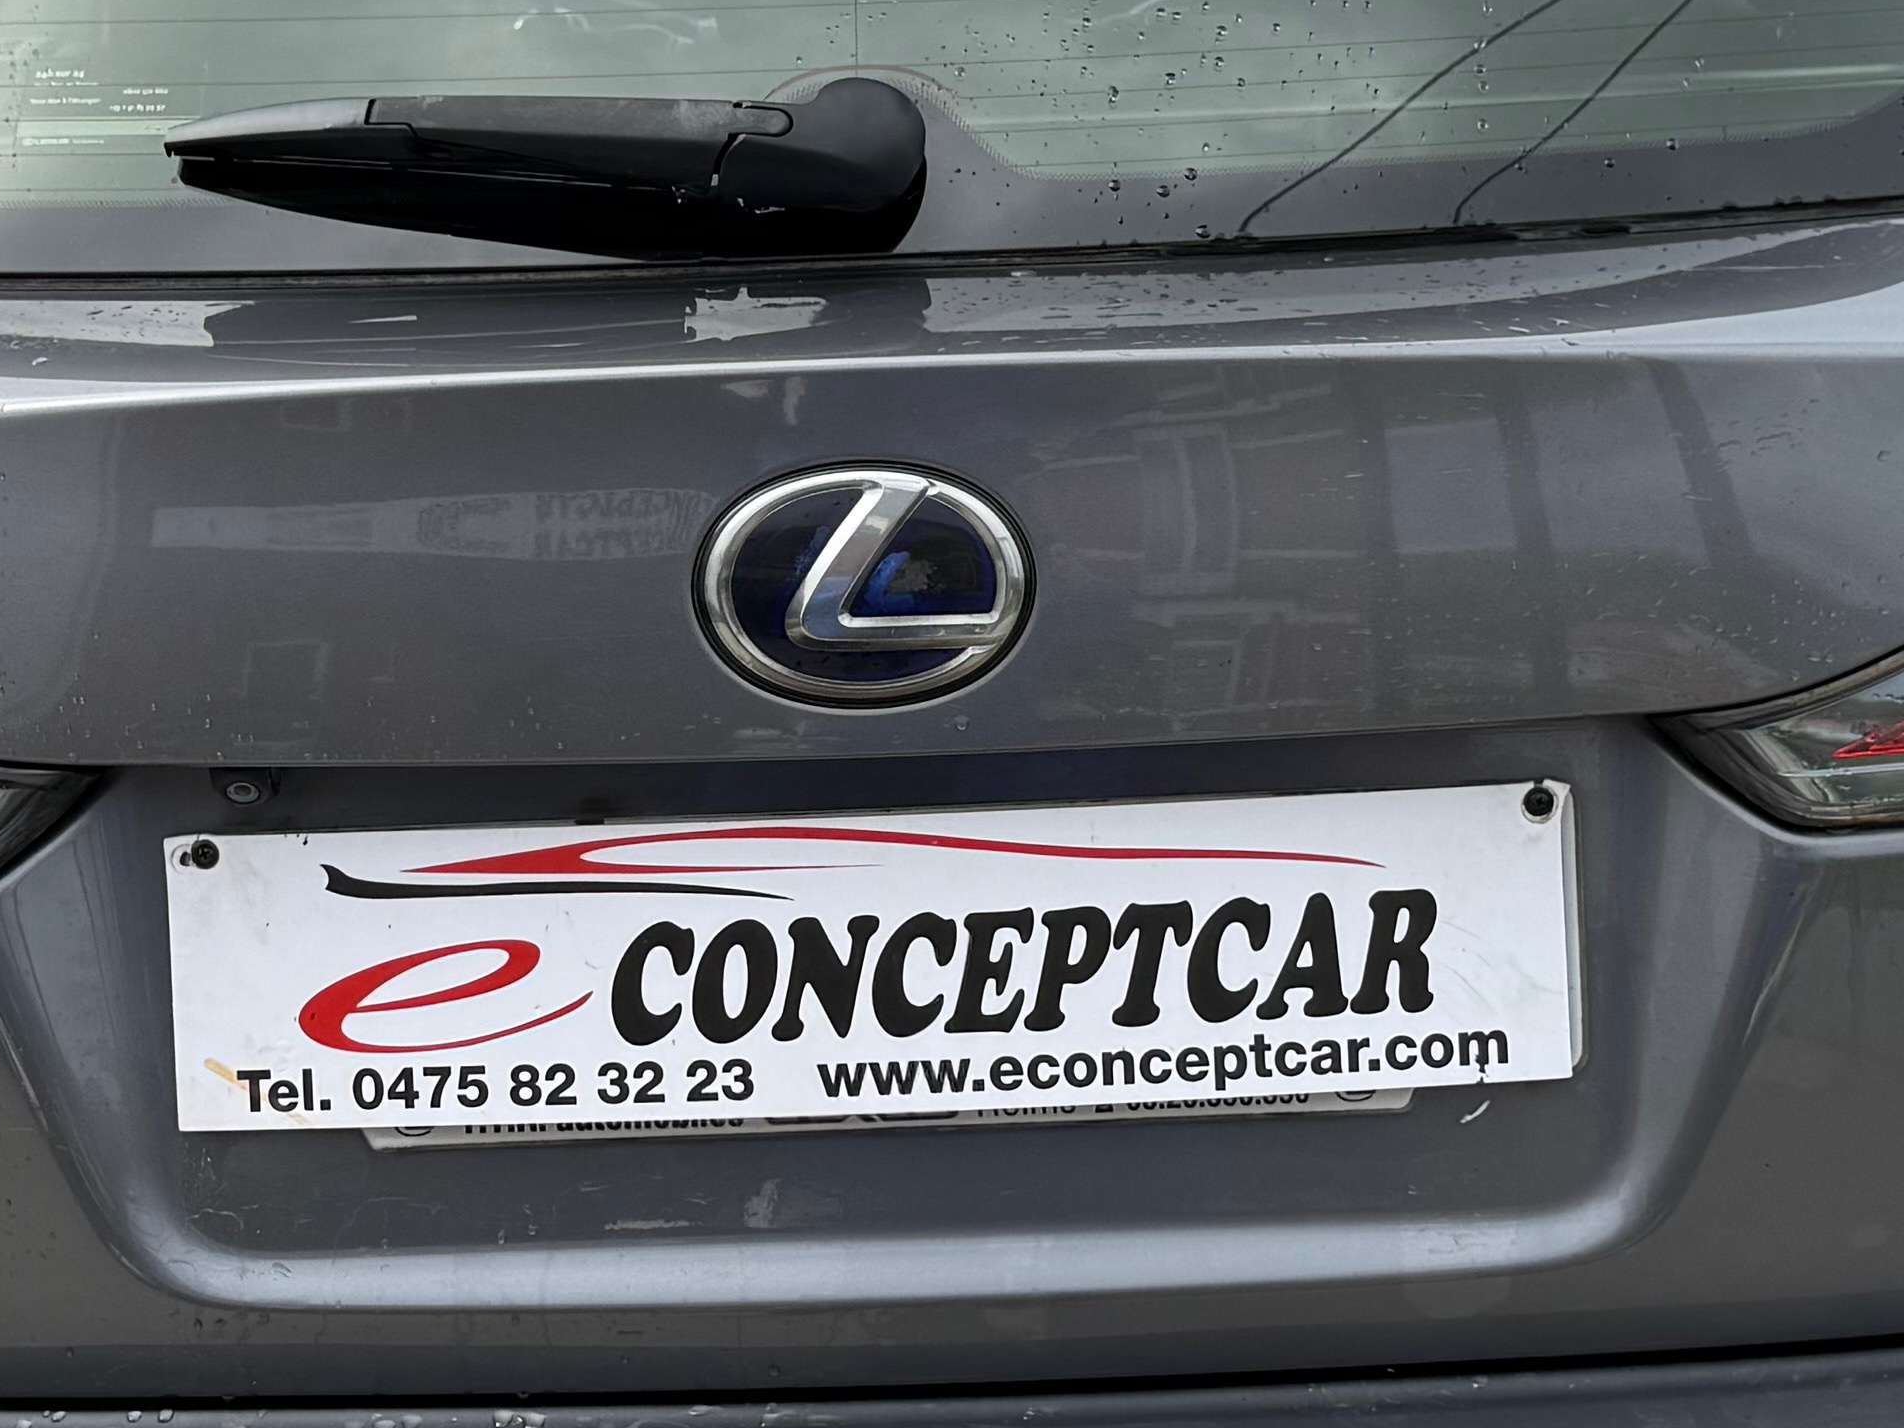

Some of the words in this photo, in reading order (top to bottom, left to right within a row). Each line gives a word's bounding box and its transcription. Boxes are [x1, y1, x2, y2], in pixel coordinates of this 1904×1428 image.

[611, 889, 1438, 1045] CONCEPTCAR
[237, 1069, 332, 1112] Tel.
[352, 1065, 489, 1109] 0475
[509, 1064, 578, 1106] 82
[596, 1062, 666, 1104] 32
[686, 1059, 754, 1101] 23
[817, 1028, 1509, 1097] www.econceptcar.com
